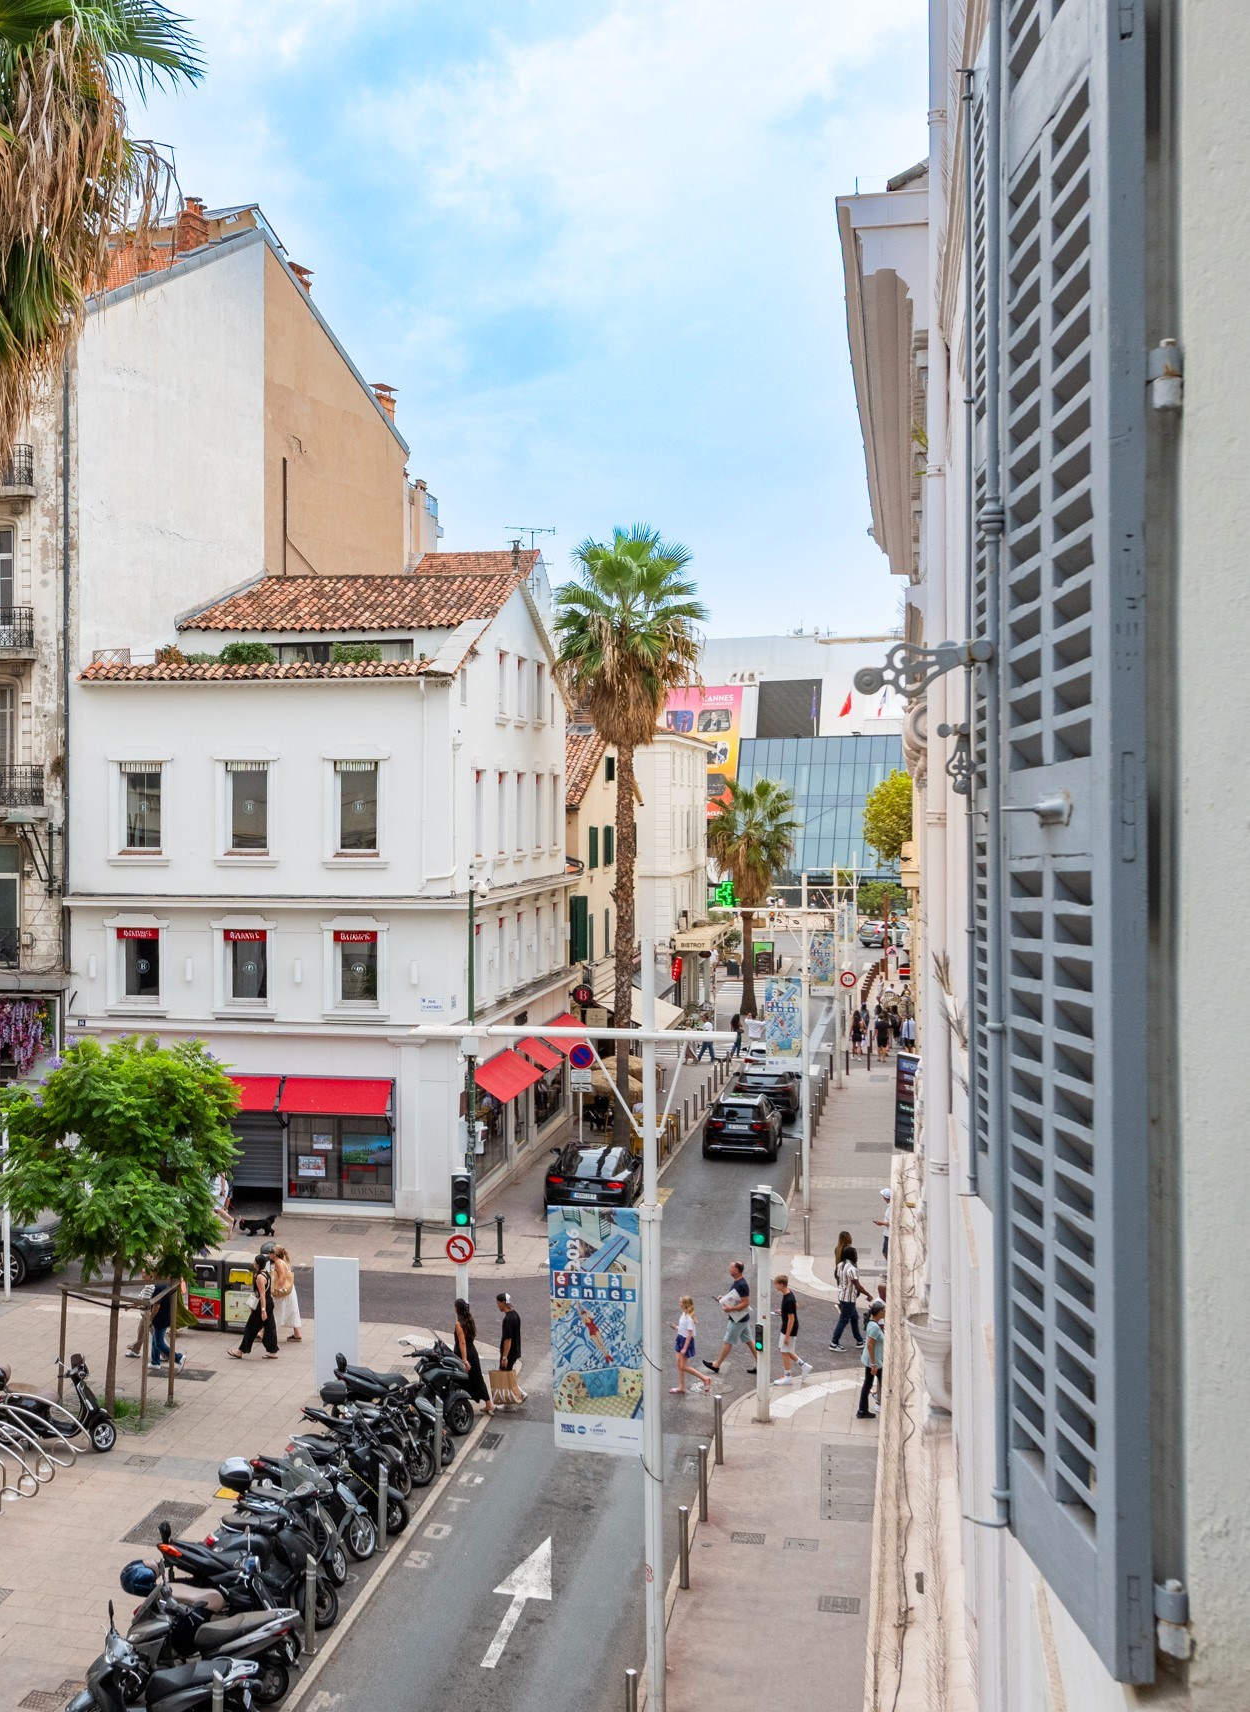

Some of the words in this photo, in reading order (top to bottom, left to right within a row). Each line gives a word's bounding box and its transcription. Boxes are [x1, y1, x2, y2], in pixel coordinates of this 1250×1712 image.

[702, 694, 734, 703] CANNES
[579, 989, 588, 1001] B
[350, 1186, 386, 1197] BARNES
[564, 1228, 581, 1271] 2026
[557, 1271, 593, 1286] été
[610, 1273, 620, 1287] à
[557, 1287, 633, 1301] cannes
